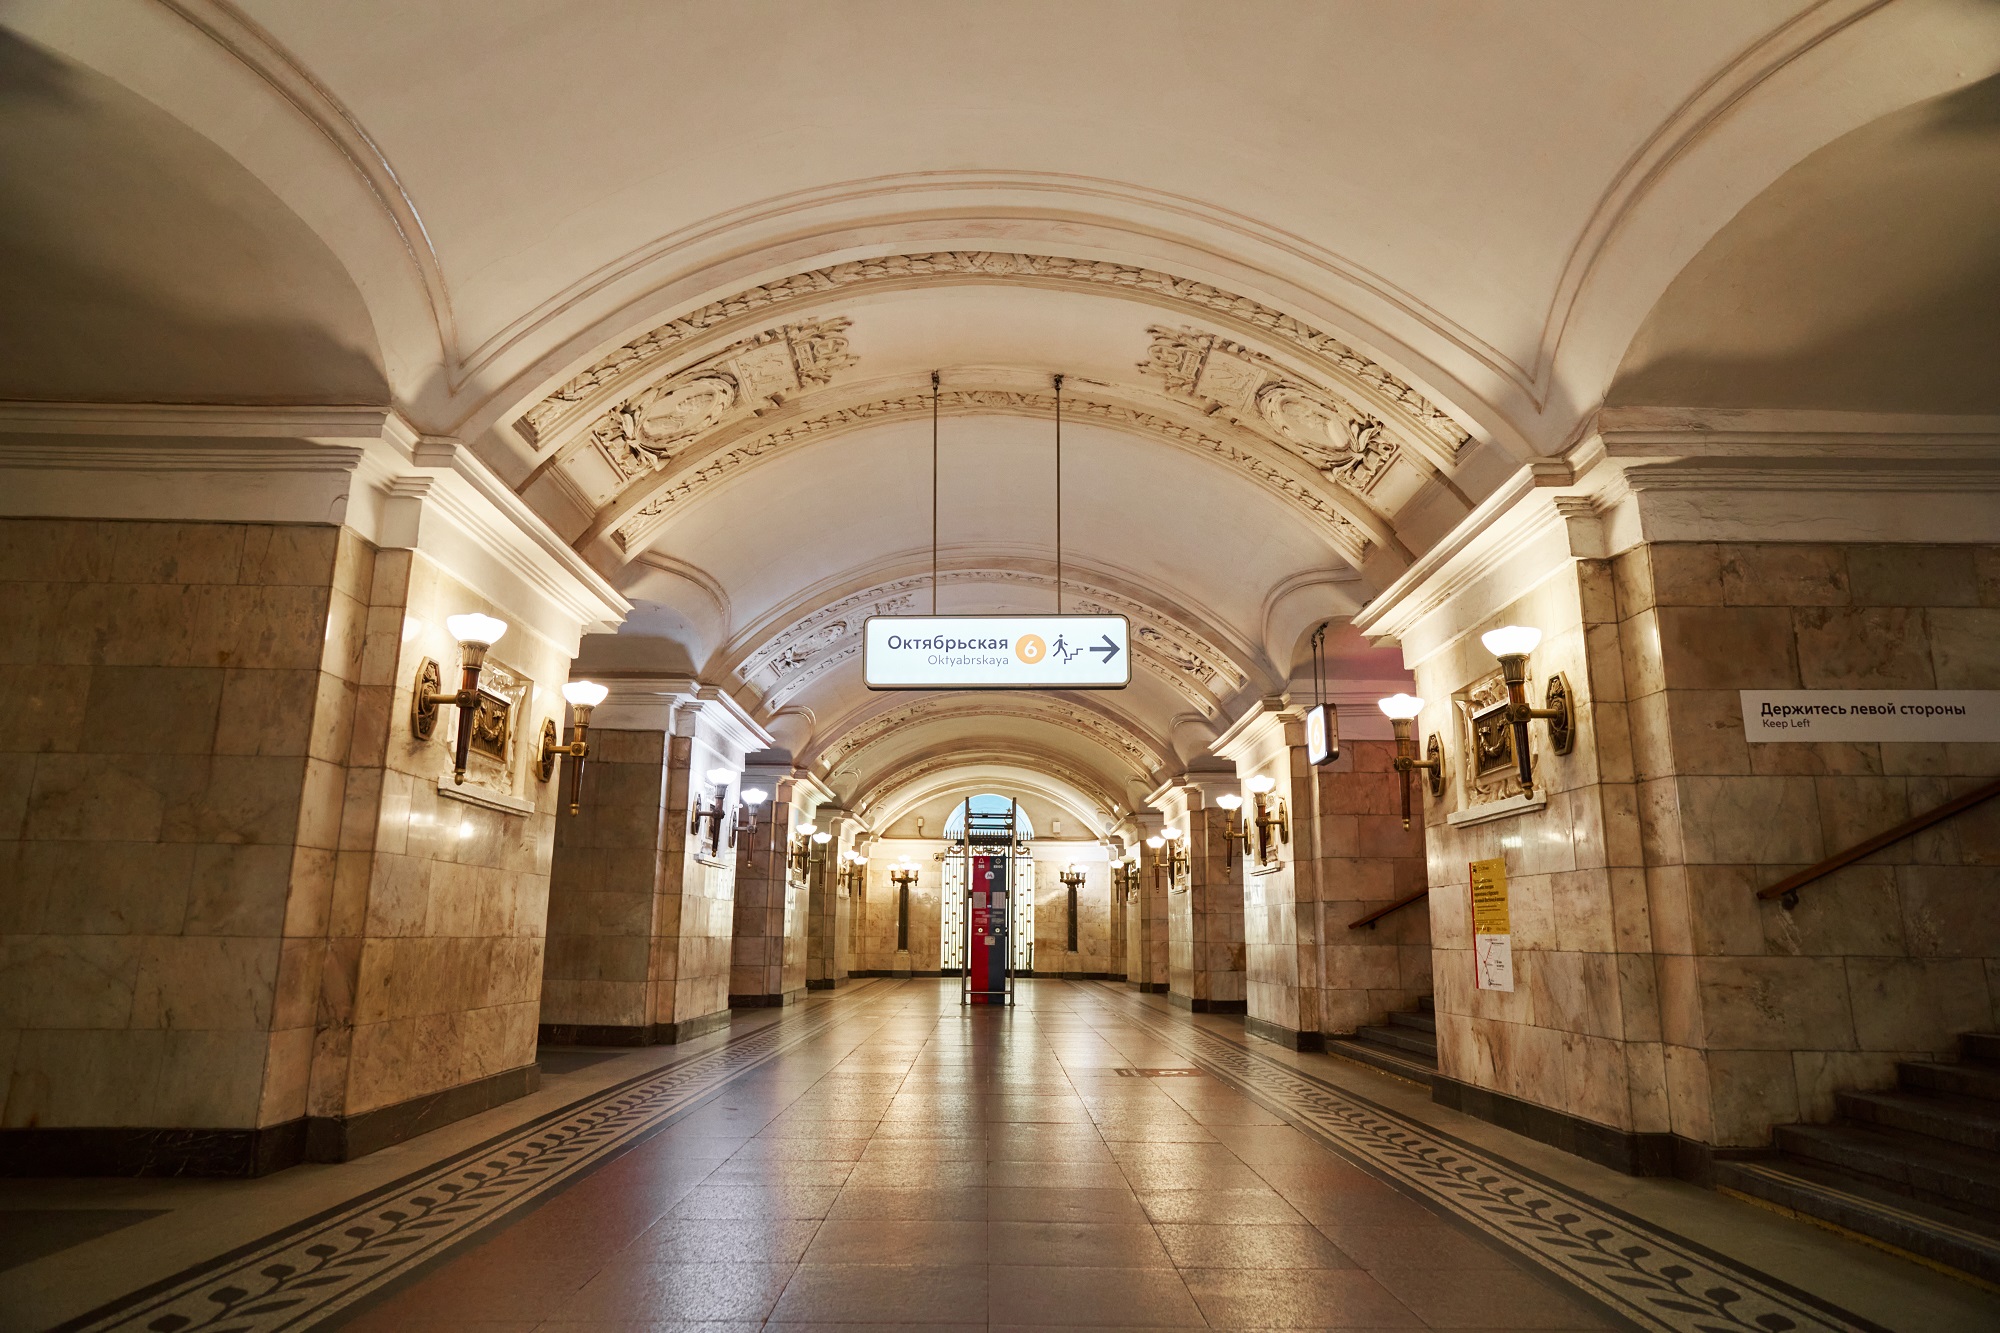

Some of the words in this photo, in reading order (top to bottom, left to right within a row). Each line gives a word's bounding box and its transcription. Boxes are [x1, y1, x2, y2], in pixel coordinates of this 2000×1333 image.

[887, 634, 1009, 652] Октябрьская
[1024, 640, 1038, 658] 6
[927, 654, 1009, 667] Oktyabrskaya
[1761, 702, 1847, 718] Держитесь
[1850, 702, 1896, 715] левой
[1900, 703, 1966, 717] стороны
[1762, 719, 1789, 729] Keep
[1791, 718, 1811, 728] Left
